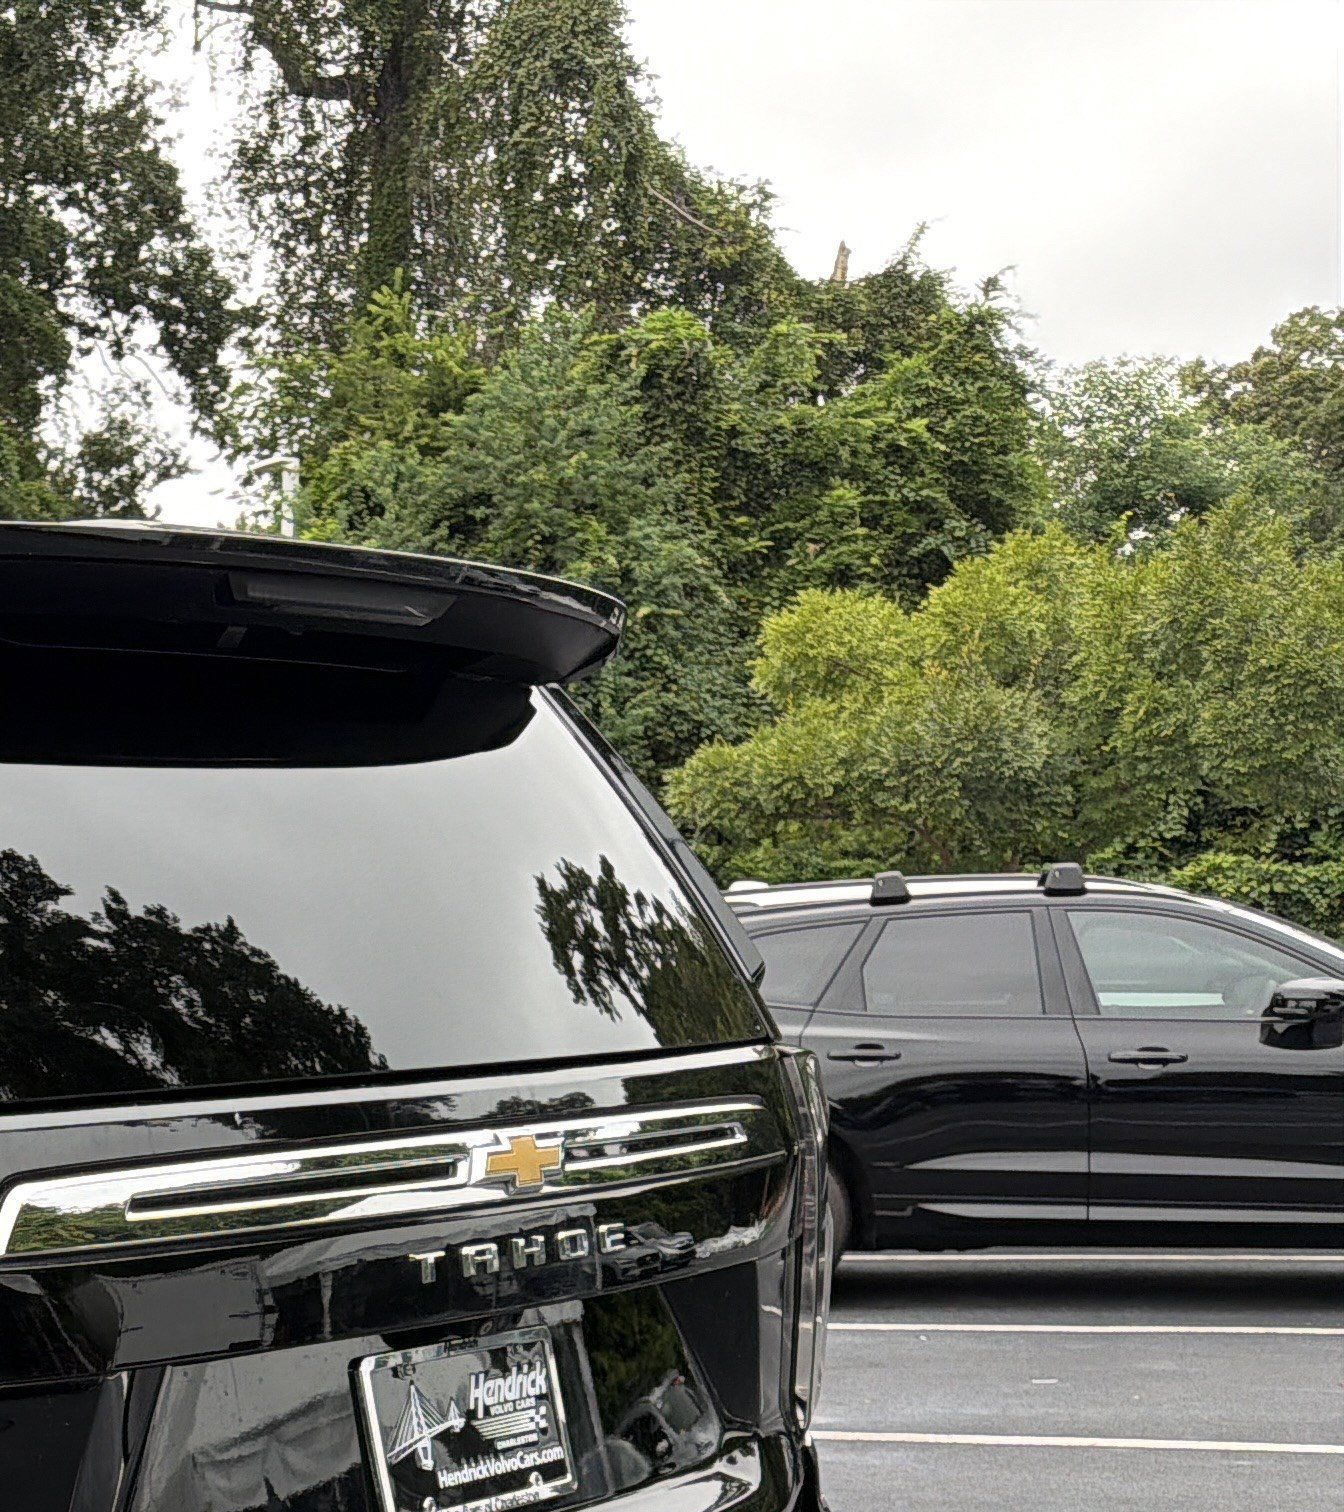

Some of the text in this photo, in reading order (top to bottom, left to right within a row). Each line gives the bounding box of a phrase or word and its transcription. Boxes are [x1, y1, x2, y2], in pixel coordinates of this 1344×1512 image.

[409, 1222, 625, 1285] TAHOE
[469, 1361, 547, 1419] Hendrick
[437, 1446, 565, 1489] HendrickVolvoCars.com
